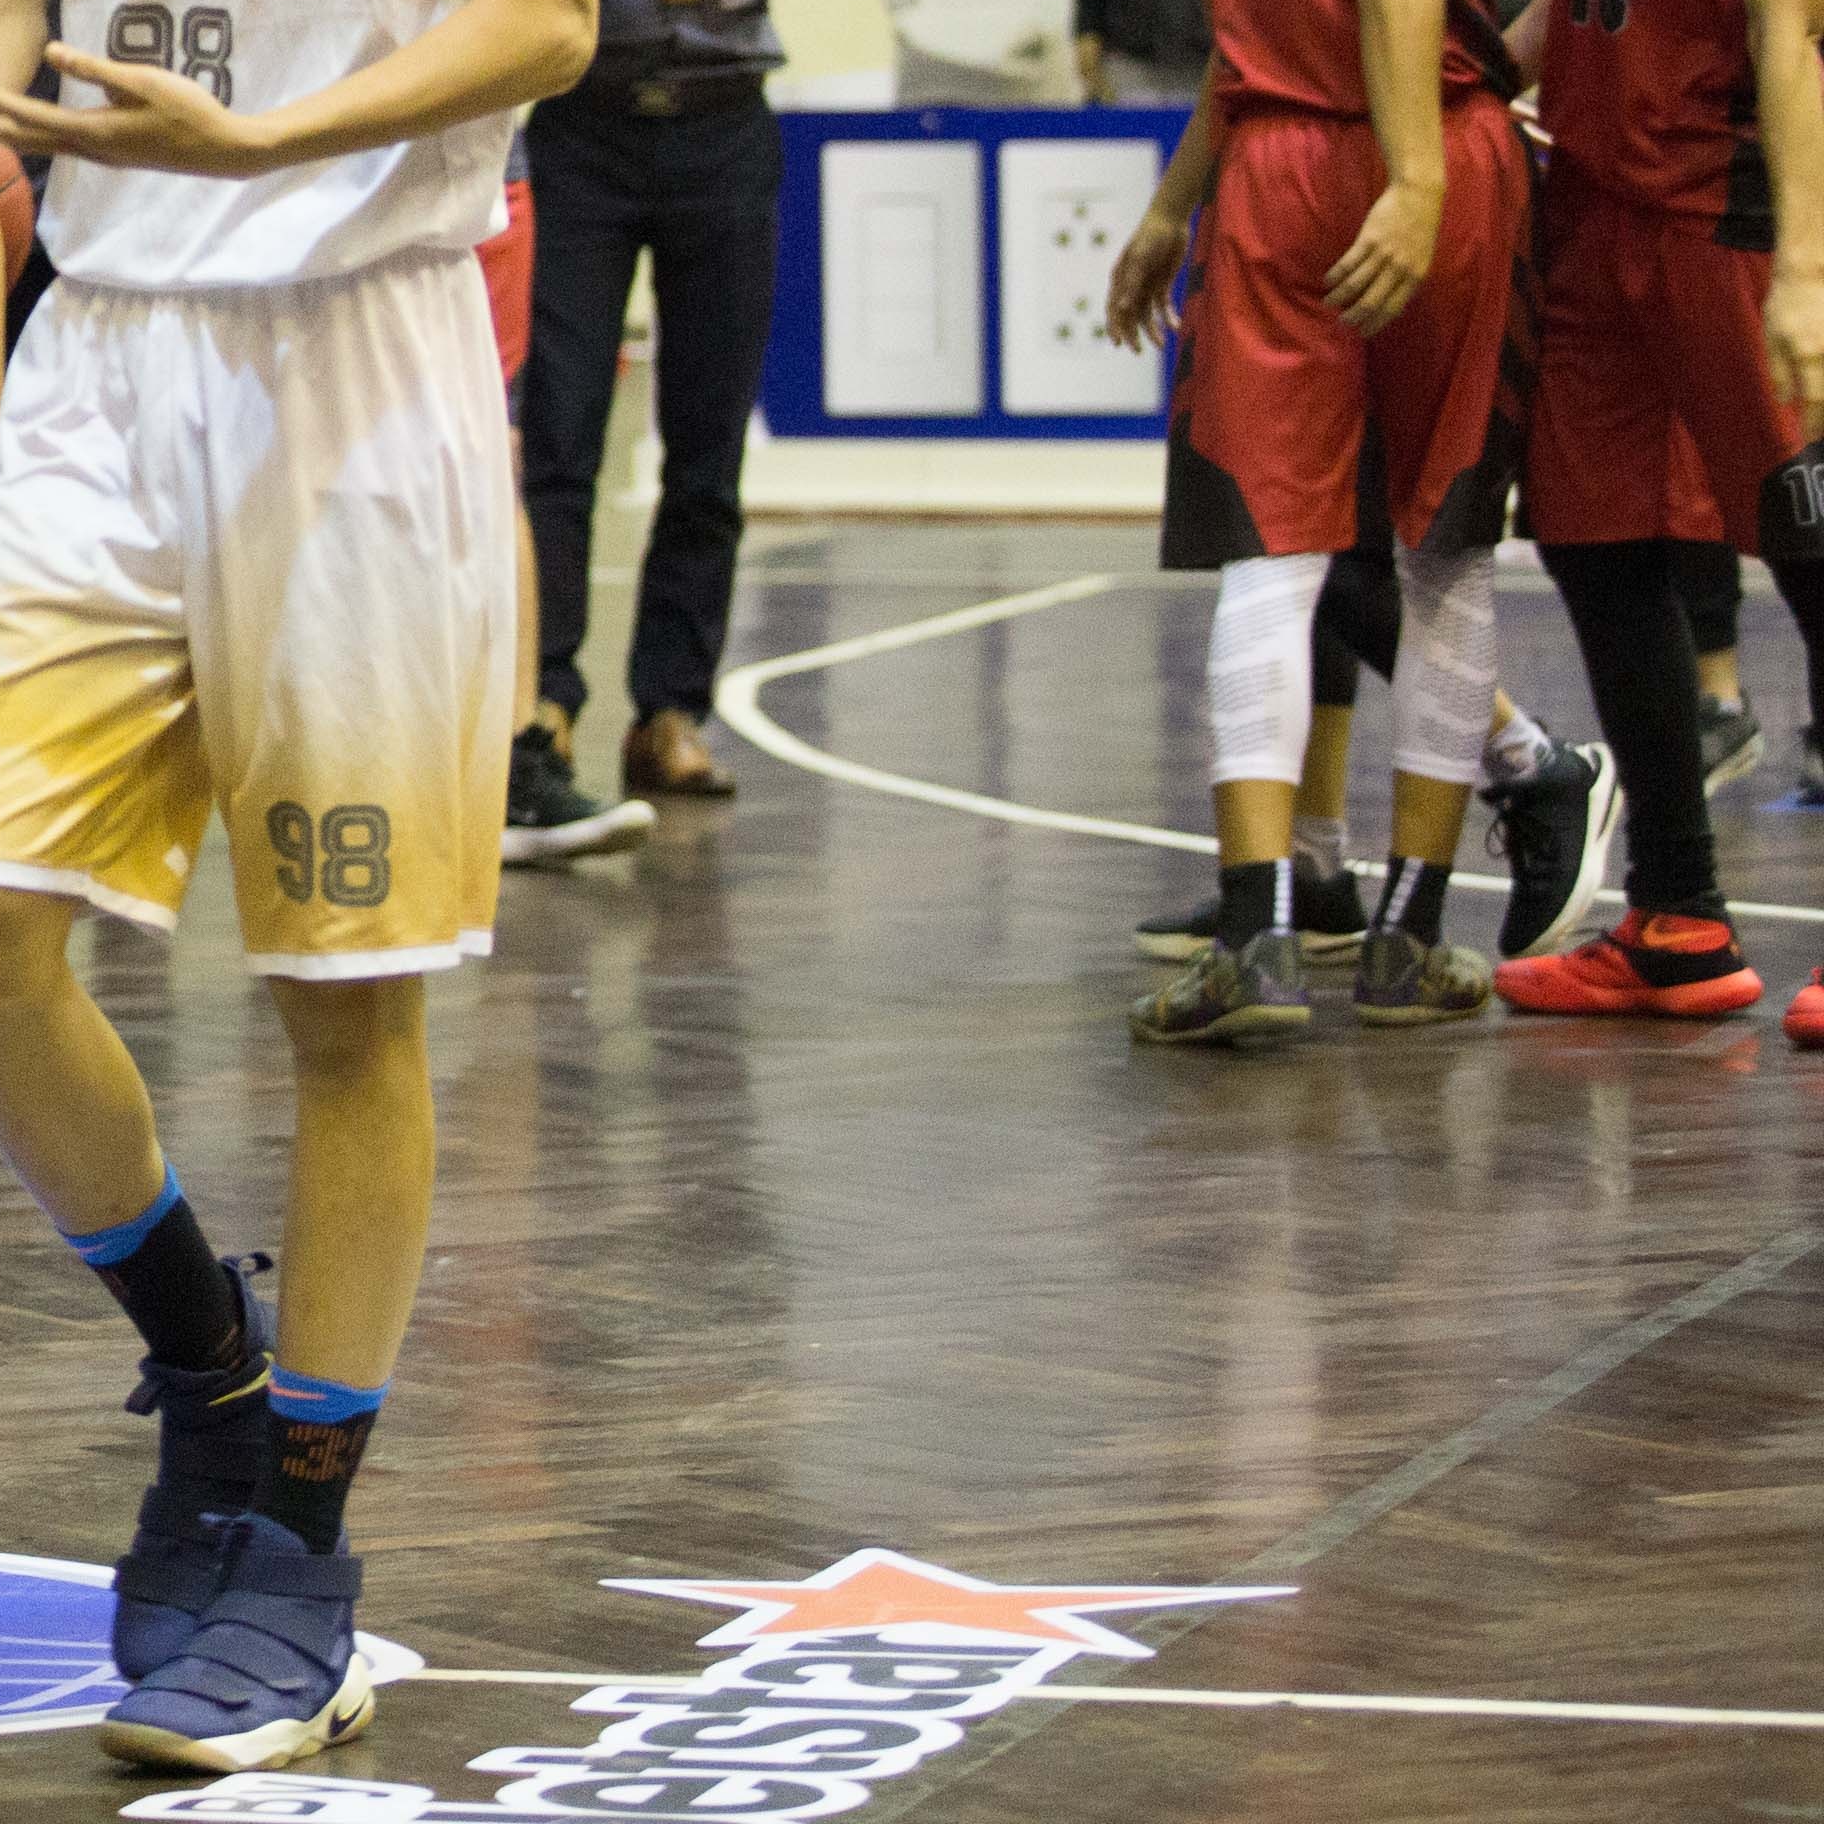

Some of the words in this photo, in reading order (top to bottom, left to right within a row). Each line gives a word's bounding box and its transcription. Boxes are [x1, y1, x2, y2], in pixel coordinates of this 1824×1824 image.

[106, 2, 233, 108] 98
[266, 800, 393, 908] 98
[437, 1631, 1030, 1824] etstar
